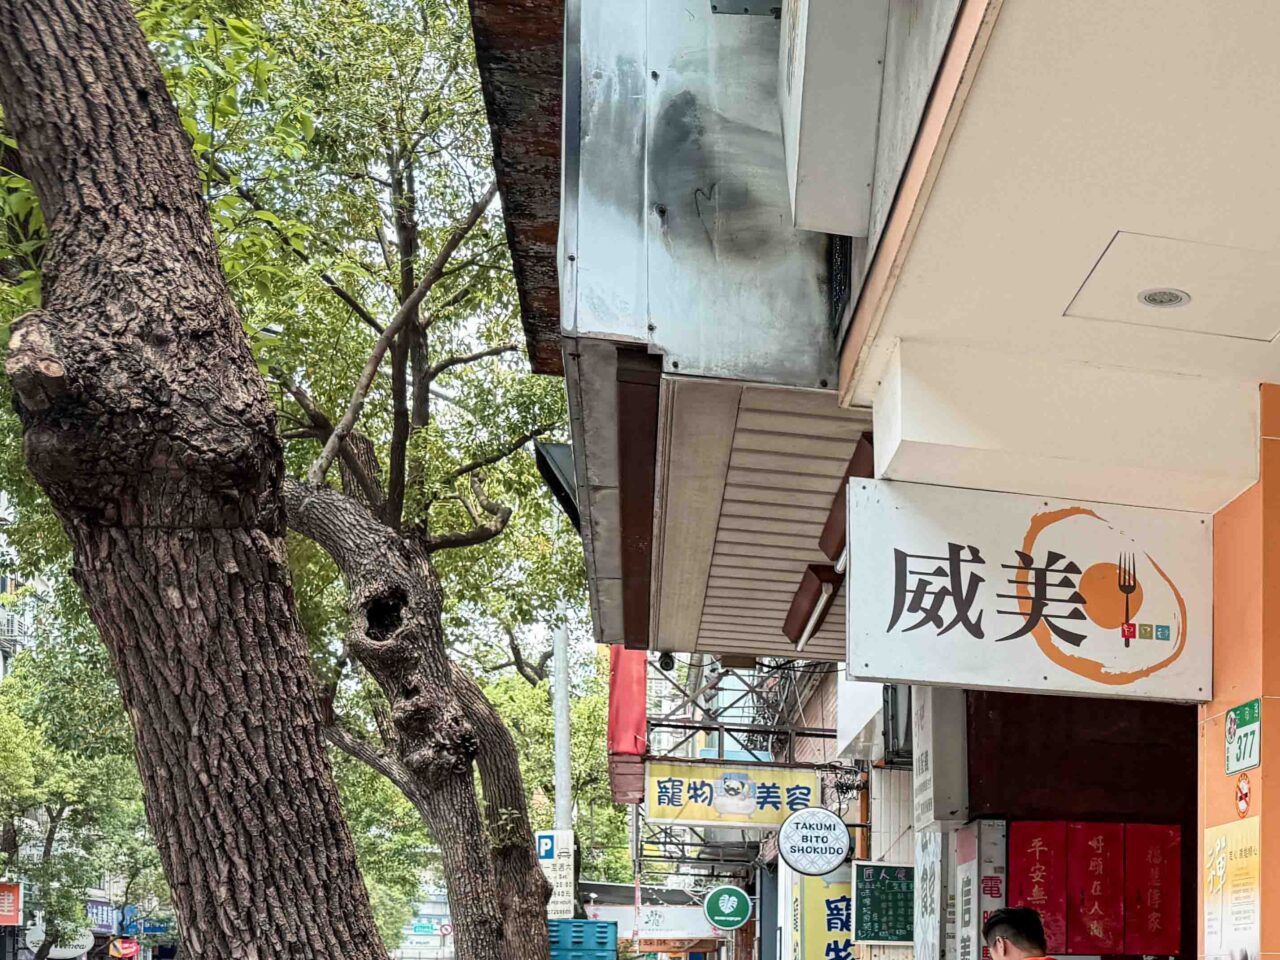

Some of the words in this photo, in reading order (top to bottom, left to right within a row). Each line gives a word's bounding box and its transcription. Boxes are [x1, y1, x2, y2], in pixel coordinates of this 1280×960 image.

[887, 543, 1087, 647] 威美
[1236, 730, 1256, 762] 377
[656, 777, 714, 807] 寵物
[756, 782, 811, 812] 美容
[793, 822, 836, 832] TAKUMI
[540, 838, 552, 856] P
[801, 835, 829, 845] BITO
[790, 845, 844, 856] SHOKUDO
